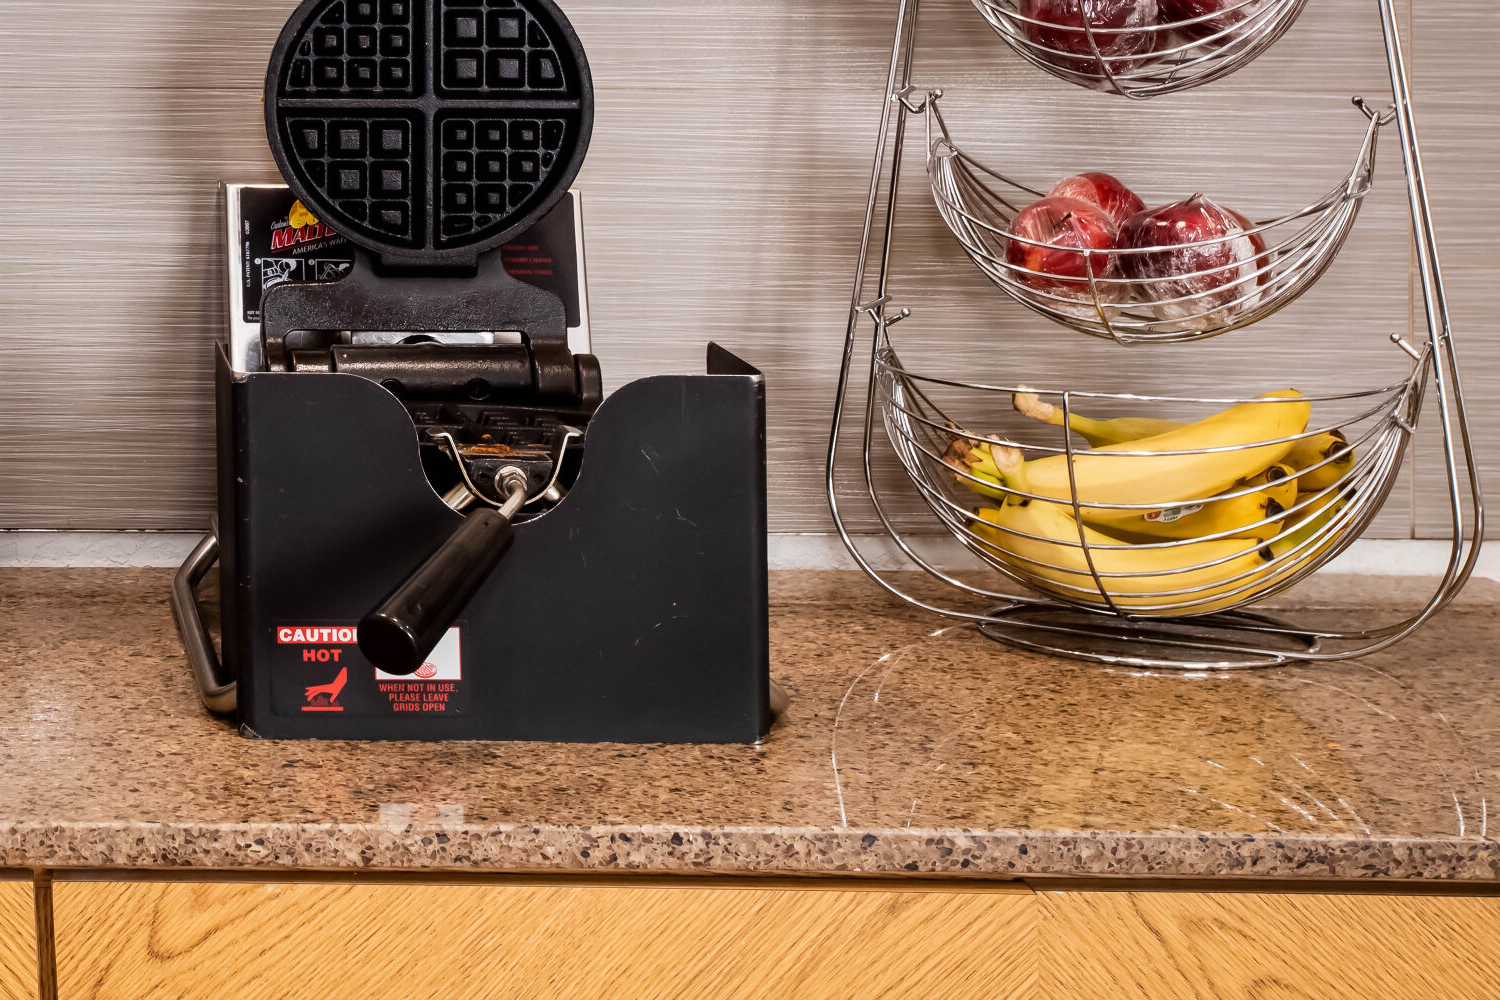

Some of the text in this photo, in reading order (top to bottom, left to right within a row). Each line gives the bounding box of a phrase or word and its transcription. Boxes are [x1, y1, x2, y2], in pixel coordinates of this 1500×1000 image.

[271, 222, 337, 250] MALT
[292, 241, 328, 256] AMERICA'S
[302, 649, 342, 662] HOT
[379, 683, 459, 693] WHEN NOT IN USE,
[388, 693, 449, 702] PLEASE LEAVE
[393, 703, 446, 711] GRIDS OPEN
